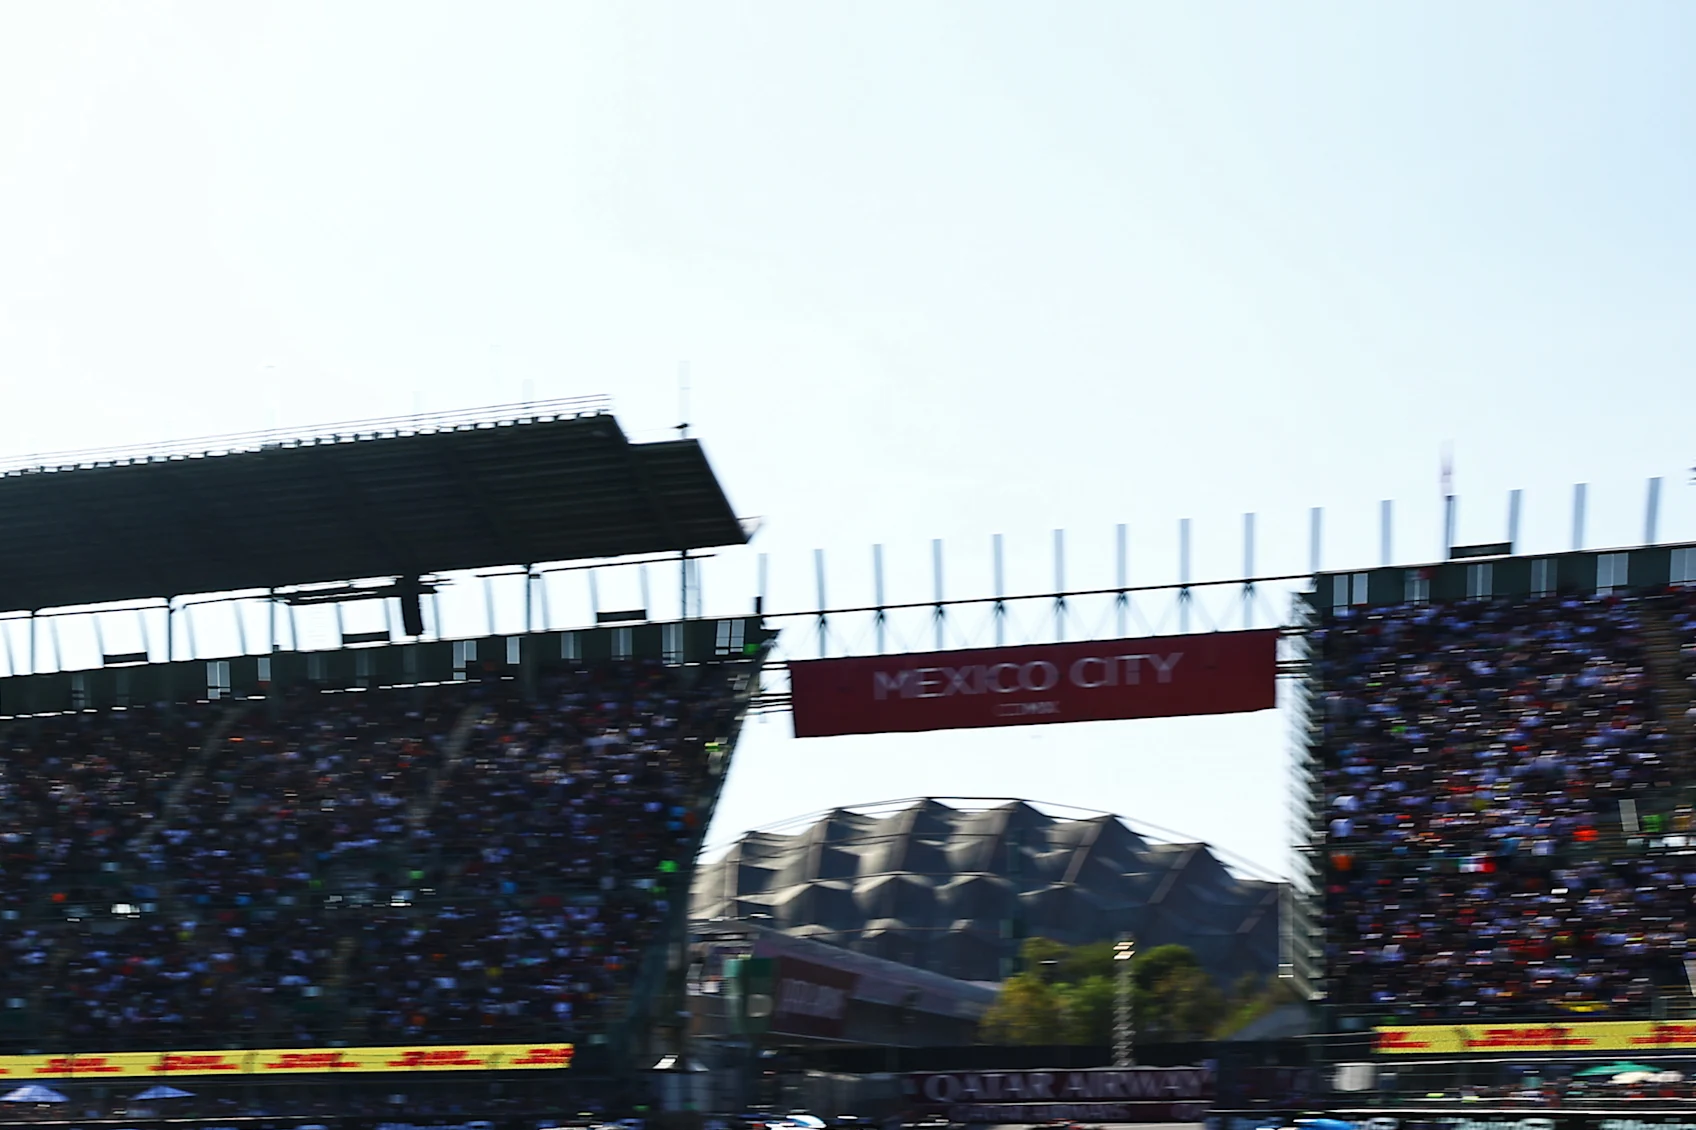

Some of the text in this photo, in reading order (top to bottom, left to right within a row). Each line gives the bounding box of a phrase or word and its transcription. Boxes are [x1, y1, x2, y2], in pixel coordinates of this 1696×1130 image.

[873, 652, 1184, 700] MEXICO CITY
[924, 1071, 1206, 1102] QATAR AIRWAY
